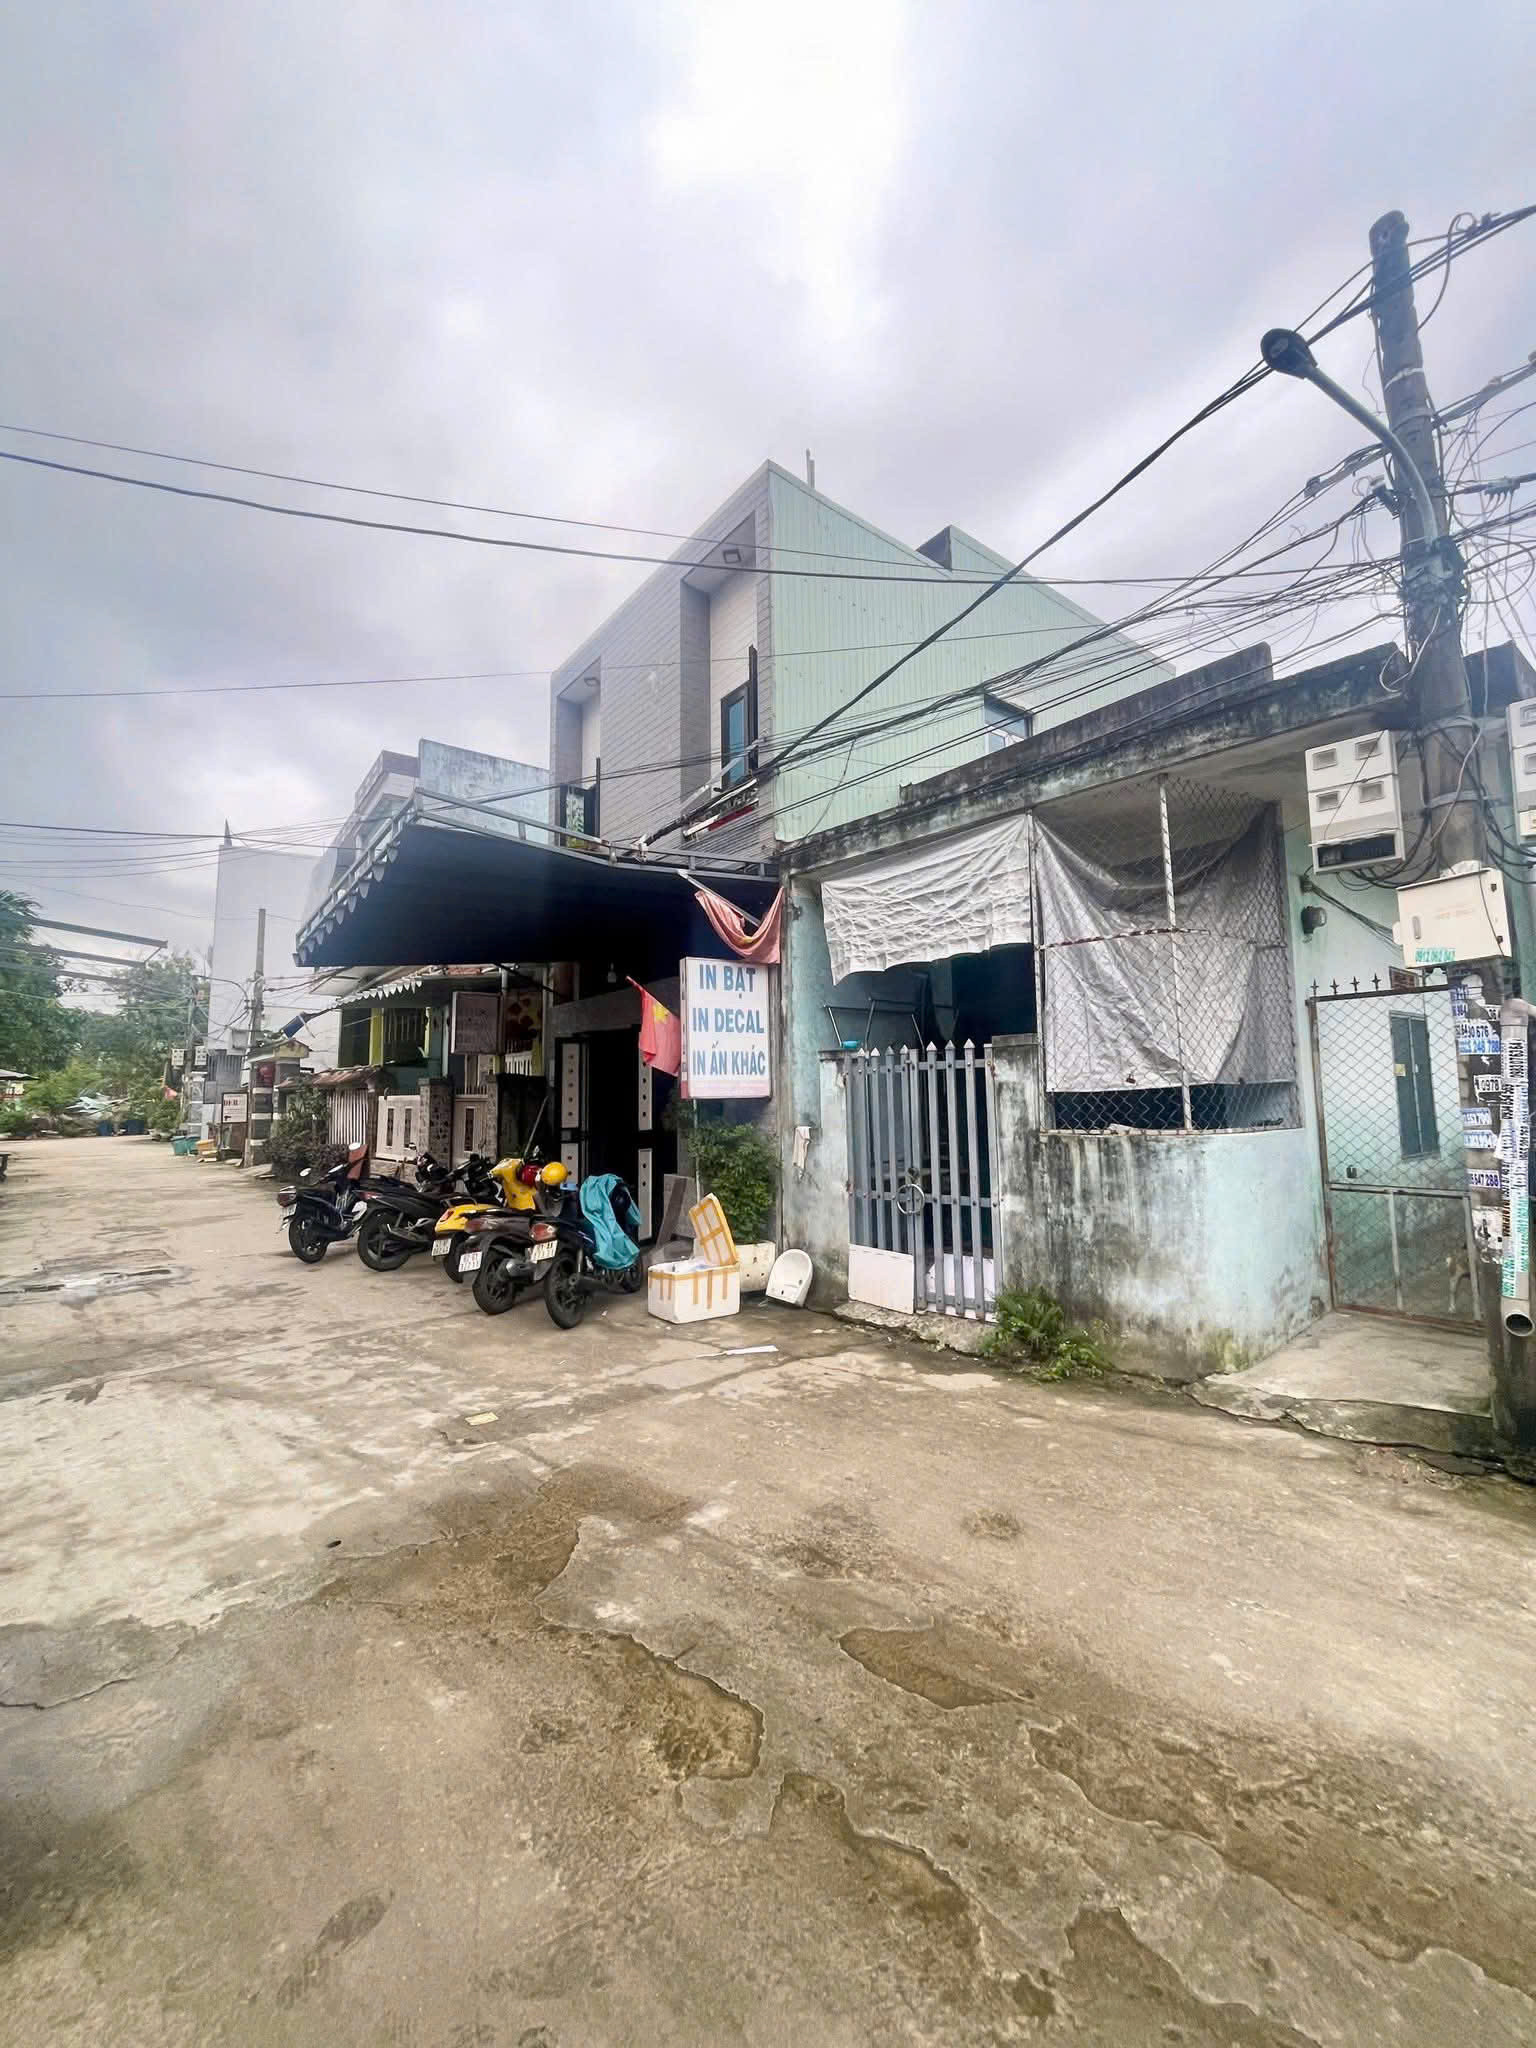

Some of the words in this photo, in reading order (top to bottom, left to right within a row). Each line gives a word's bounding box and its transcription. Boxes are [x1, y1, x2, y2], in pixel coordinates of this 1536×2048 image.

[699, 964, 717, 990] IN
[724, 965, 756, 999] BẠT
[692, 1007, 709, 1033] IN
[714, 1008, 765, 1034] DECAL
[692, 1050, 706, 1076] IN
[710, 1040, 729, 1076] ẤN
[731, 1045, 766, 1076] KHÁC
